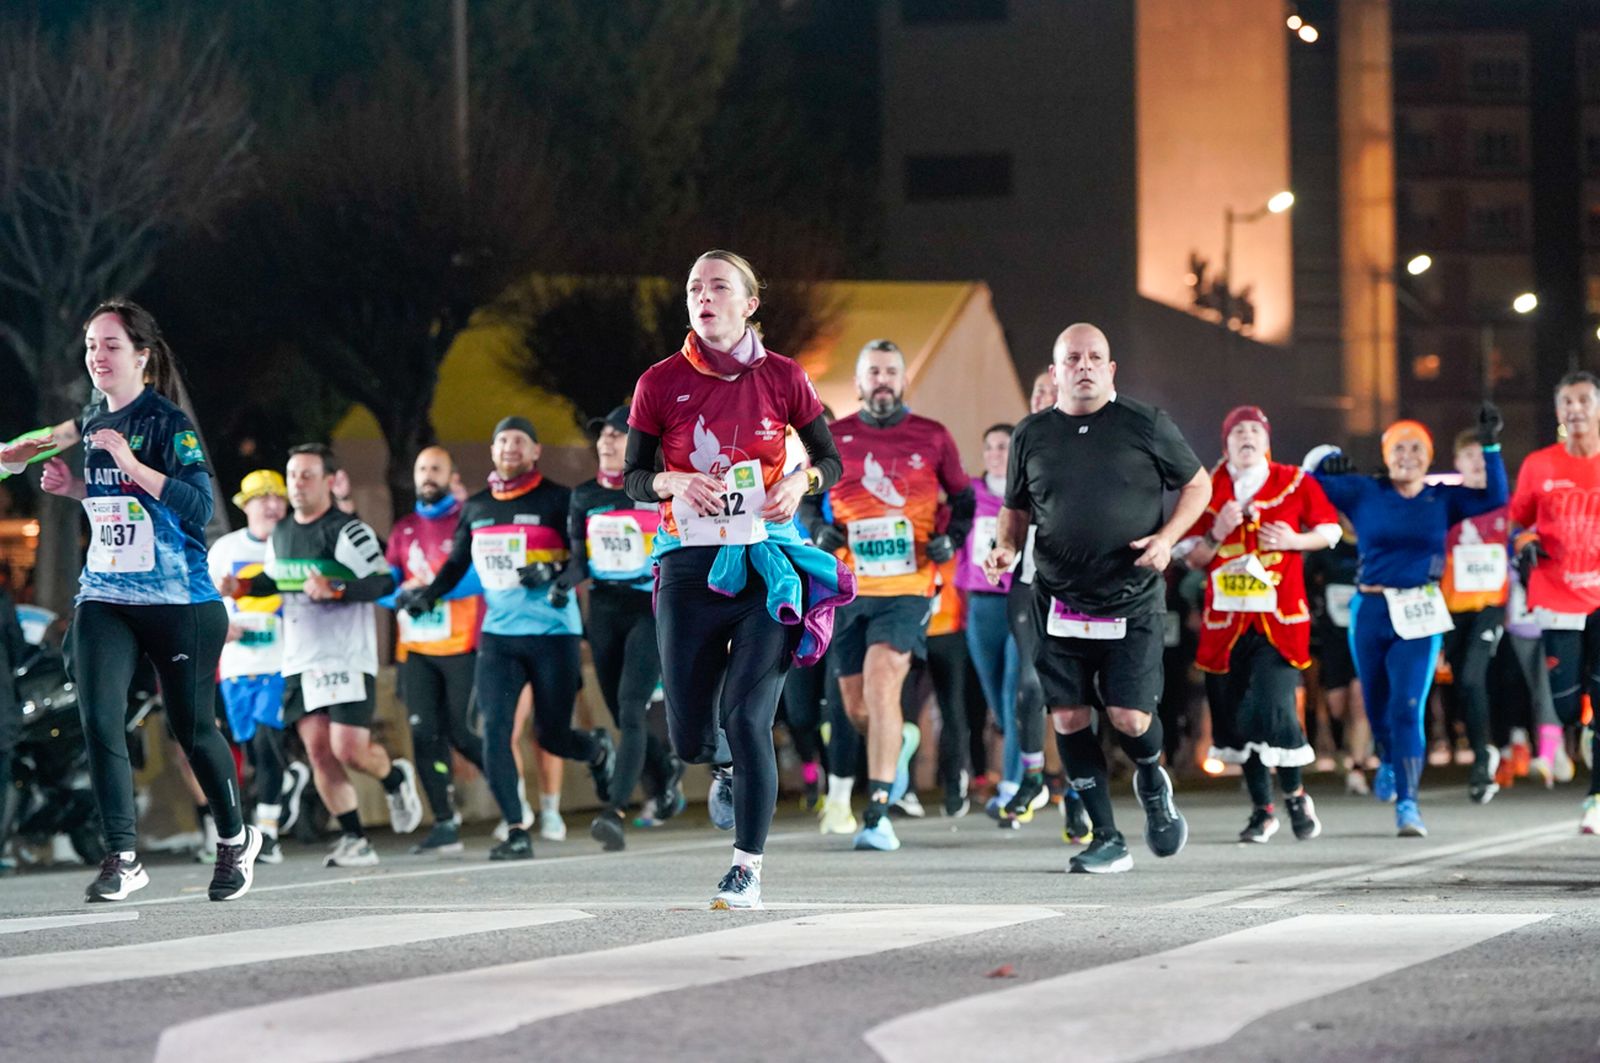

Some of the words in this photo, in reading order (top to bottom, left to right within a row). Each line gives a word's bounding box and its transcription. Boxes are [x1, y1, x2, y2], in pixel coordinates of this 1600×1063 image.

[100, 524, 136, 546] 4037
[856, 538, 907, 556] 14039
[485, 555, 513, 570] 1765
